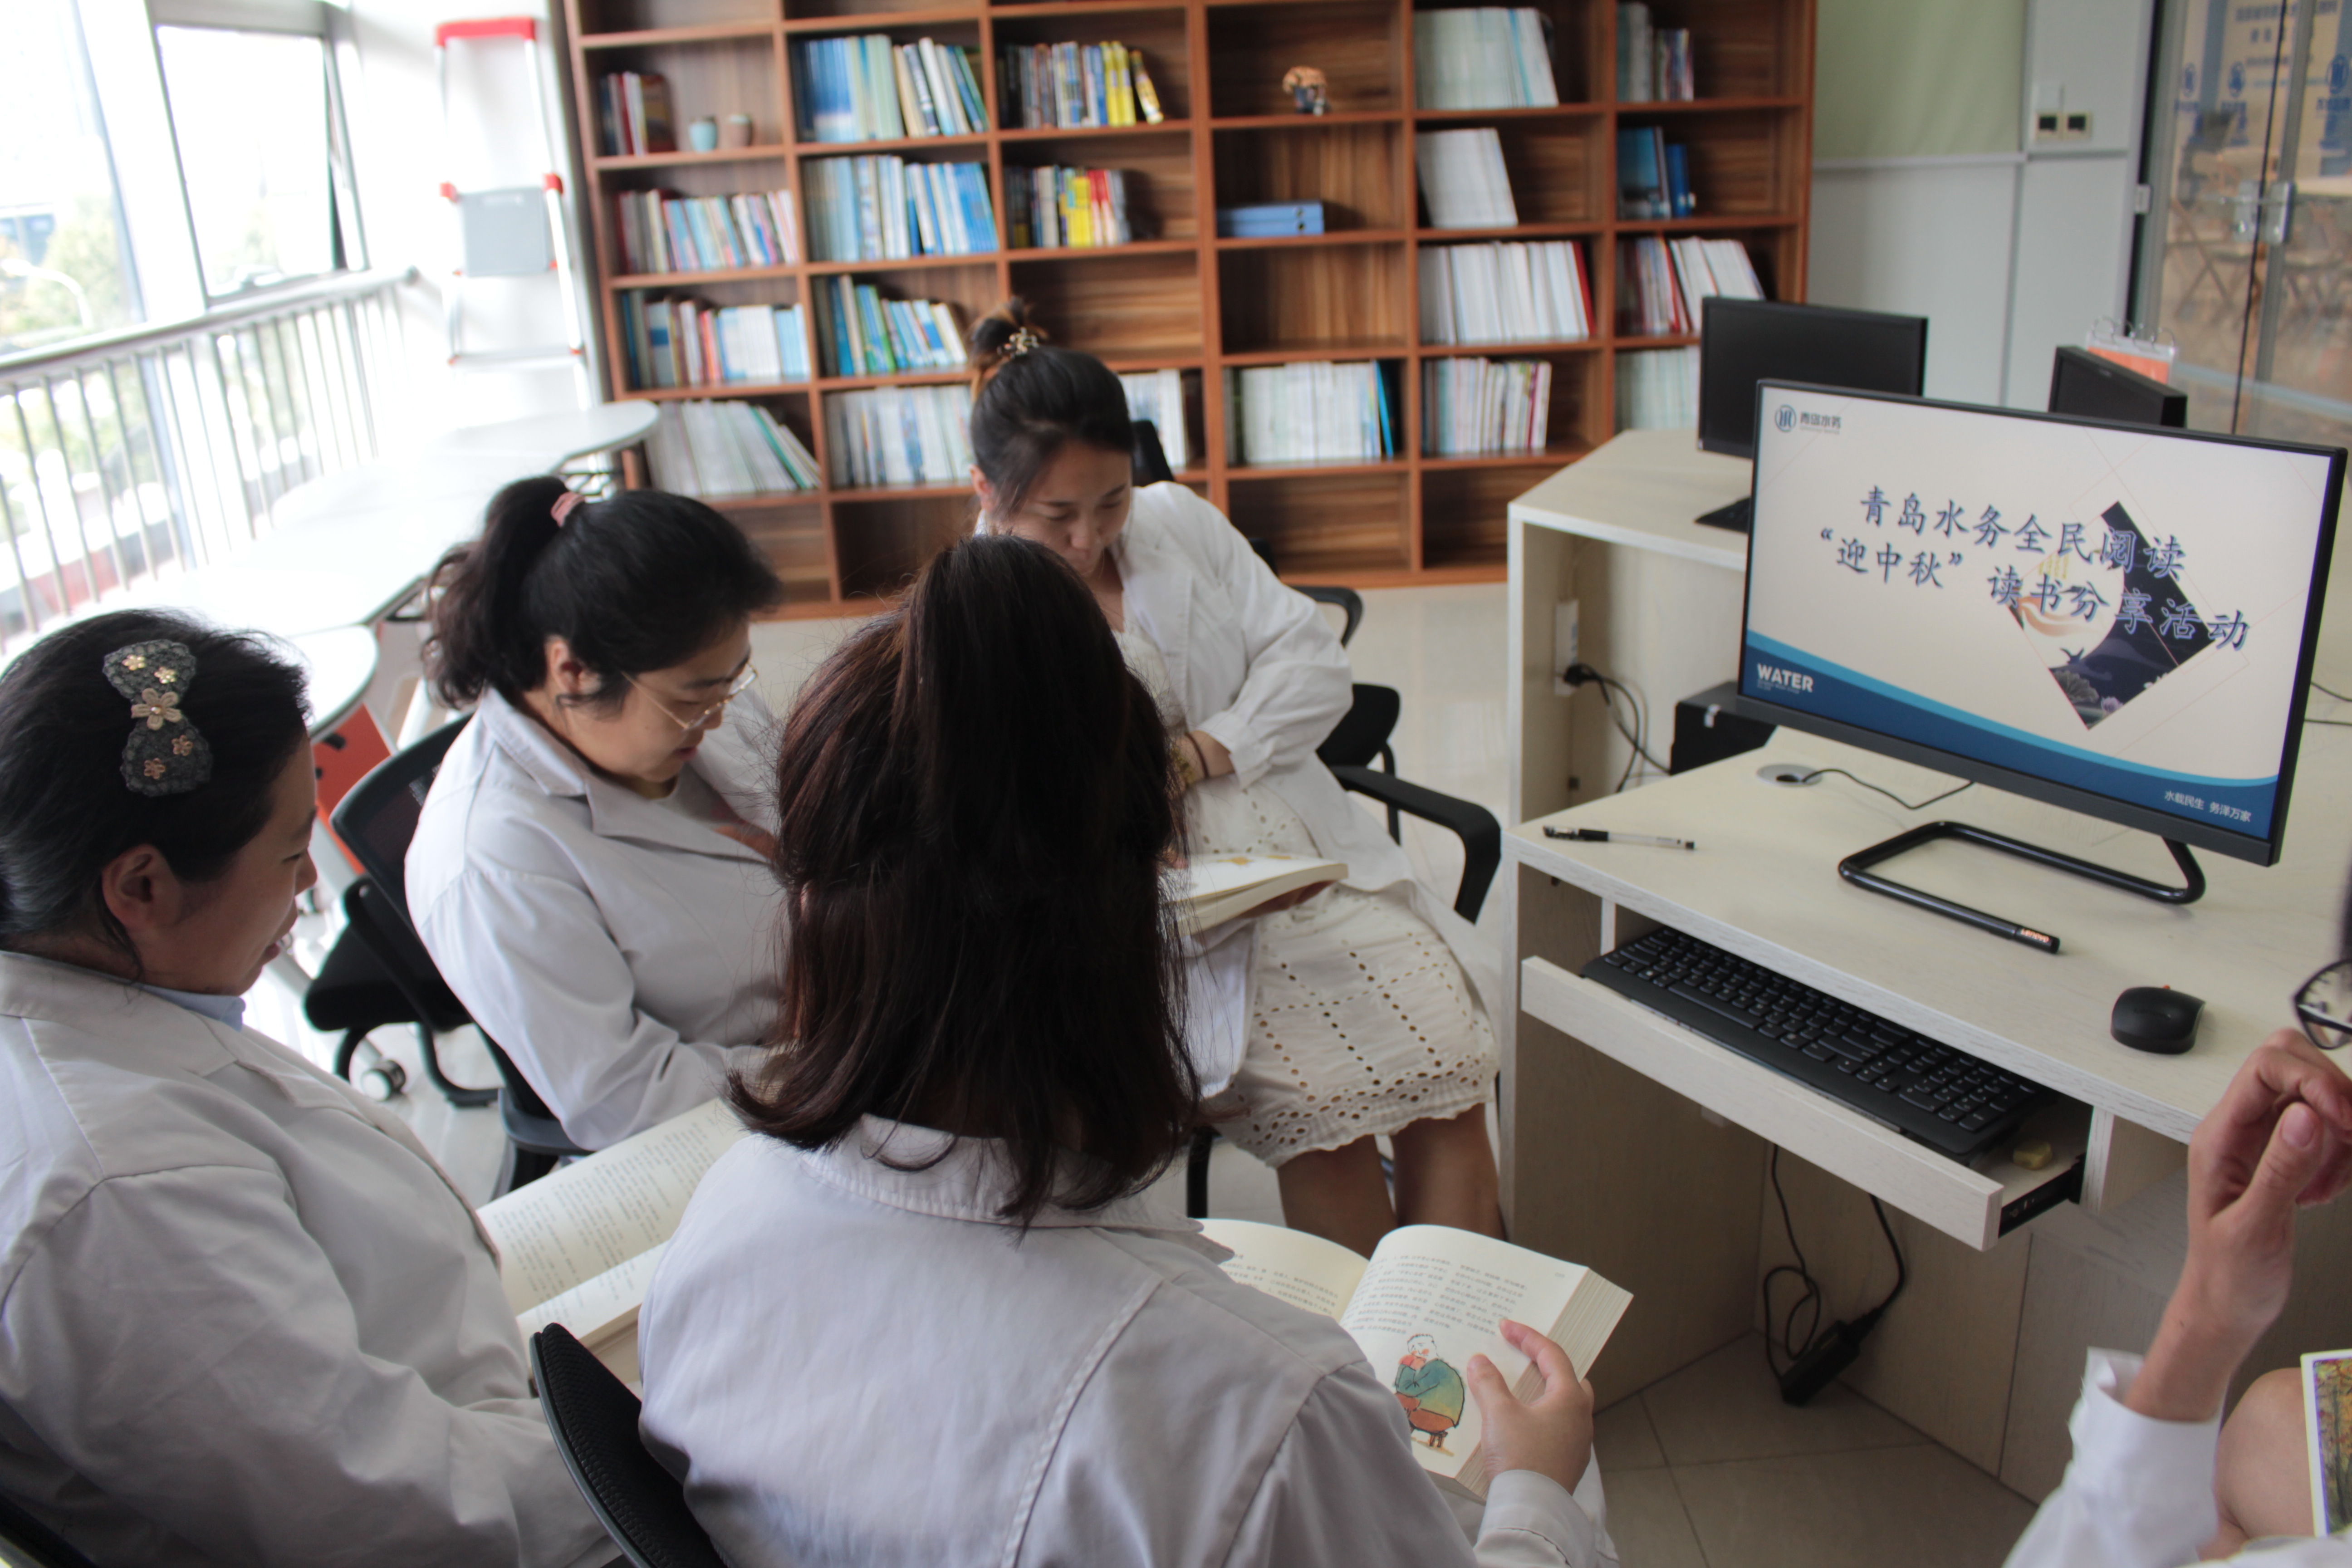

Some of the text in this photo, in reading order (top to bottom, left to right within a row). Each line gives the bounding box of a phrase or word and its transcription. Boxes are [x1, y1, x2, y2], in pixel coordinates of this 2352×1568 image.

[1860, 485, 2186, 582] 青岛水务全民阅读
[1987, 564, 2250, 652] 读书分享活动
[1757, 662, 1814, 693] WATER
[2210, 802, 2251, 822] 务泽万家
